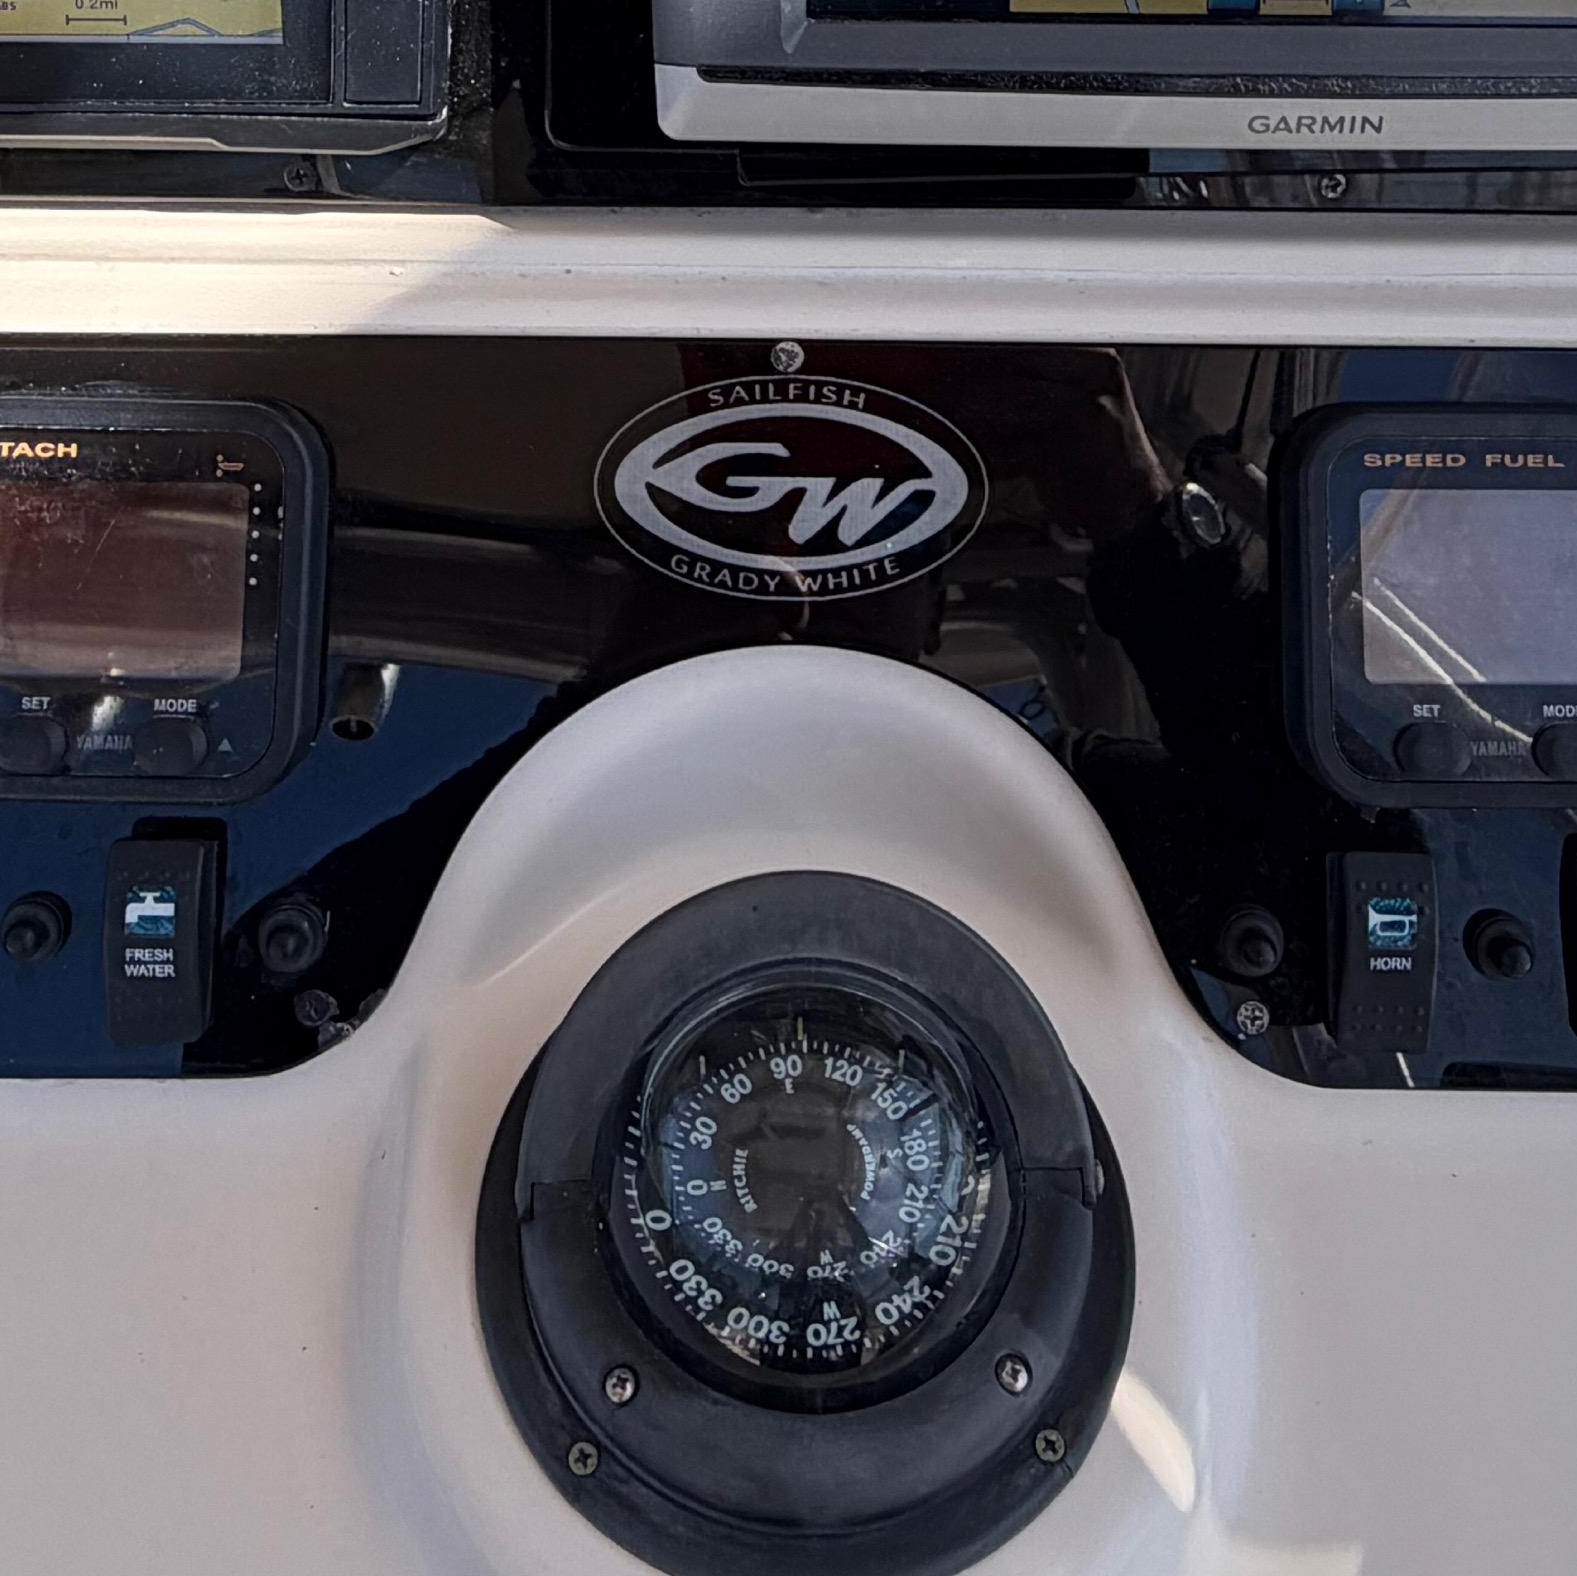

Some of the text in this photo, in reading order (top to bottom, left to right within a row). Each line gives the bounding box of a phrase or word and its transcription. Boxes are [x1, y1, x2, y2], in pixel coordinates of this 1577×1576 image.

[1247, 115, 1385, 135] GARMIN
[706, 382, 868, 411] SAILFISH
[1362, 453, 1566, 469] SPEED FUEL
[670, 554, 902, 595] GRADY WHITE
[21, 696, 198, 714] SET MODE
[1412, 704, 1442, 720] SET
[124, 947, 176, 964] FRESH
[1369, 956, 1414, 972] HORN
[123, 963, 177, 980] WATER
[770, 1054, 803, 1080] 90
[823, 1056, 863, 1087] 120
[720, 1073, 753, 1105] 60
[870, 1081, 909, 1121] 150
[689, 1116, 718, 1151] 30
[899, 1128, 929, 1172] 180
[685, 1179, 709, 1196] 0
[644, 1208, 673, 1232] 0
[928, 1214, 969, 1266] 210
[668, 1258, 724, 1312] 330
[874, 1275, 932, 1325] 240
[726, 1306, 791, 1345] 300
[806, 1316, 861, 1348] 270
